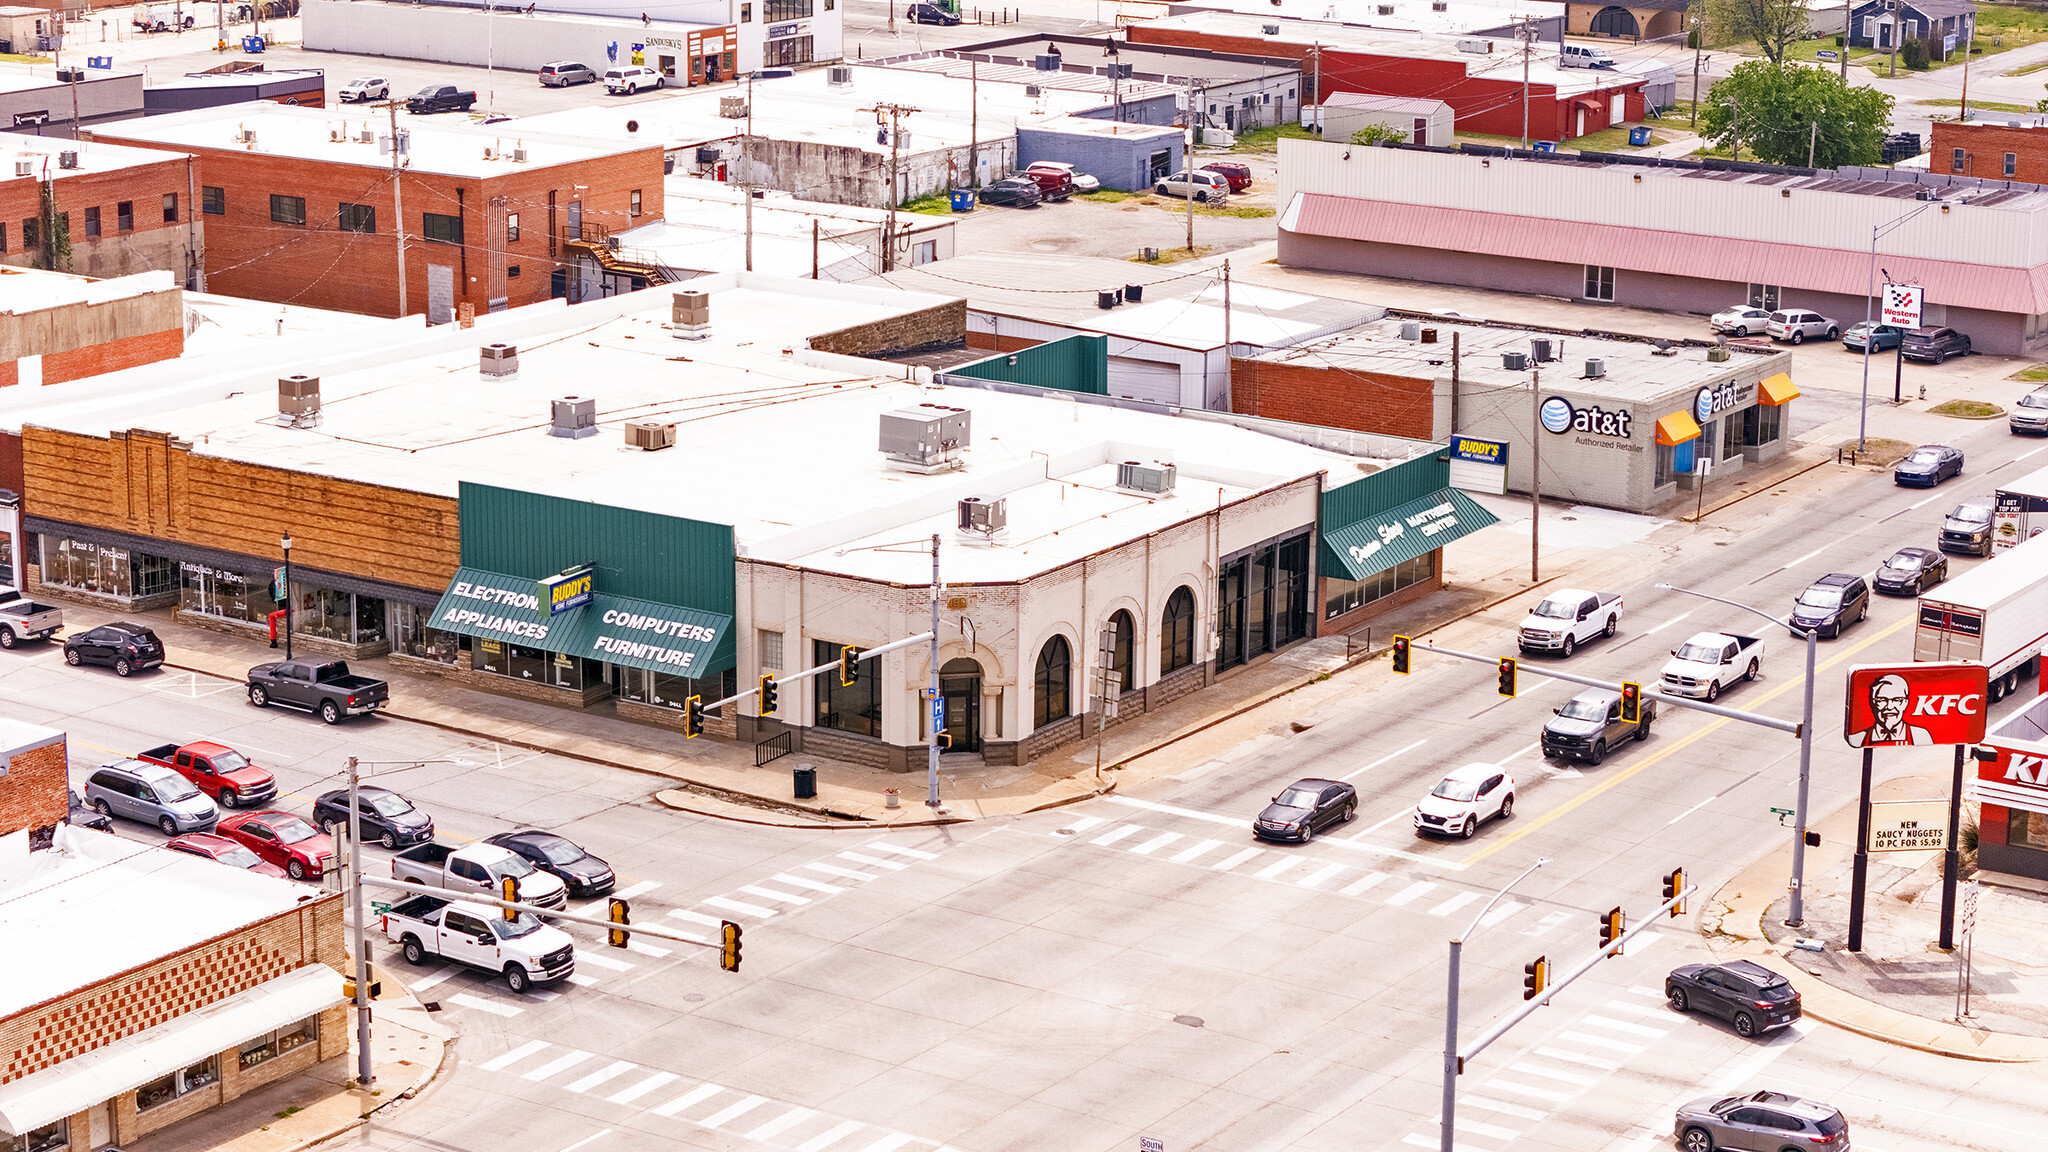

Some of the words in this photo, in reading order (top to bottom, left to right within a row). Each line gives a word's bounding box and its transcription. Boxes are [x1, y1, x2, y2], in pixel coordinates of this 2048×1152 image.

[645, 37, 682, 50] SANDUSKY'S
[1884, 308, 1918, 318] Western
[1891, 317, 1910, 325] Auto
[1574, 408, 1629, 437] at&t
[1459, 440, 1499, 456] BUDDY'S
[1575, 437, 1614, 449] Authorized
[1616, 442, 1643, 453] Retailer
[1405, 501, 1455, 528] MATTRESS
[1377, 520, 1404, 545] Shop
[1421, 515, 1458, 537] CENTER
[72, 540, 87, 551] Past
[88, 543, 95, 552] &
[100, 547, 128, 560] Present
[181, 561, 213, 575] Antiques
[216, 570, 222, 579] &
[224, 571, 243, 582] More
[452, 581, 540, 610] ELECTRON
[552, 575, 592, 604] BUDDY'S
[443, 608, 549, 640] APPLIANCES
[602, 610, 716, 642] COMPUTERS
[593, 636, 695, 668] FURNITURE
[935, 700, 942, 715] H
[1912, 694, 1980, 716] KFC
[1901, 821, 1918, 829] NEW
[1876, 830, 1904, 839] SAUCY
[1907, 829, 1943, 838] NUGGETS
[1887, 839, 1897, 848] PC
[1901, 839, 1917, 847] FOR
[1920, 838, 1941, 846] $5.99
